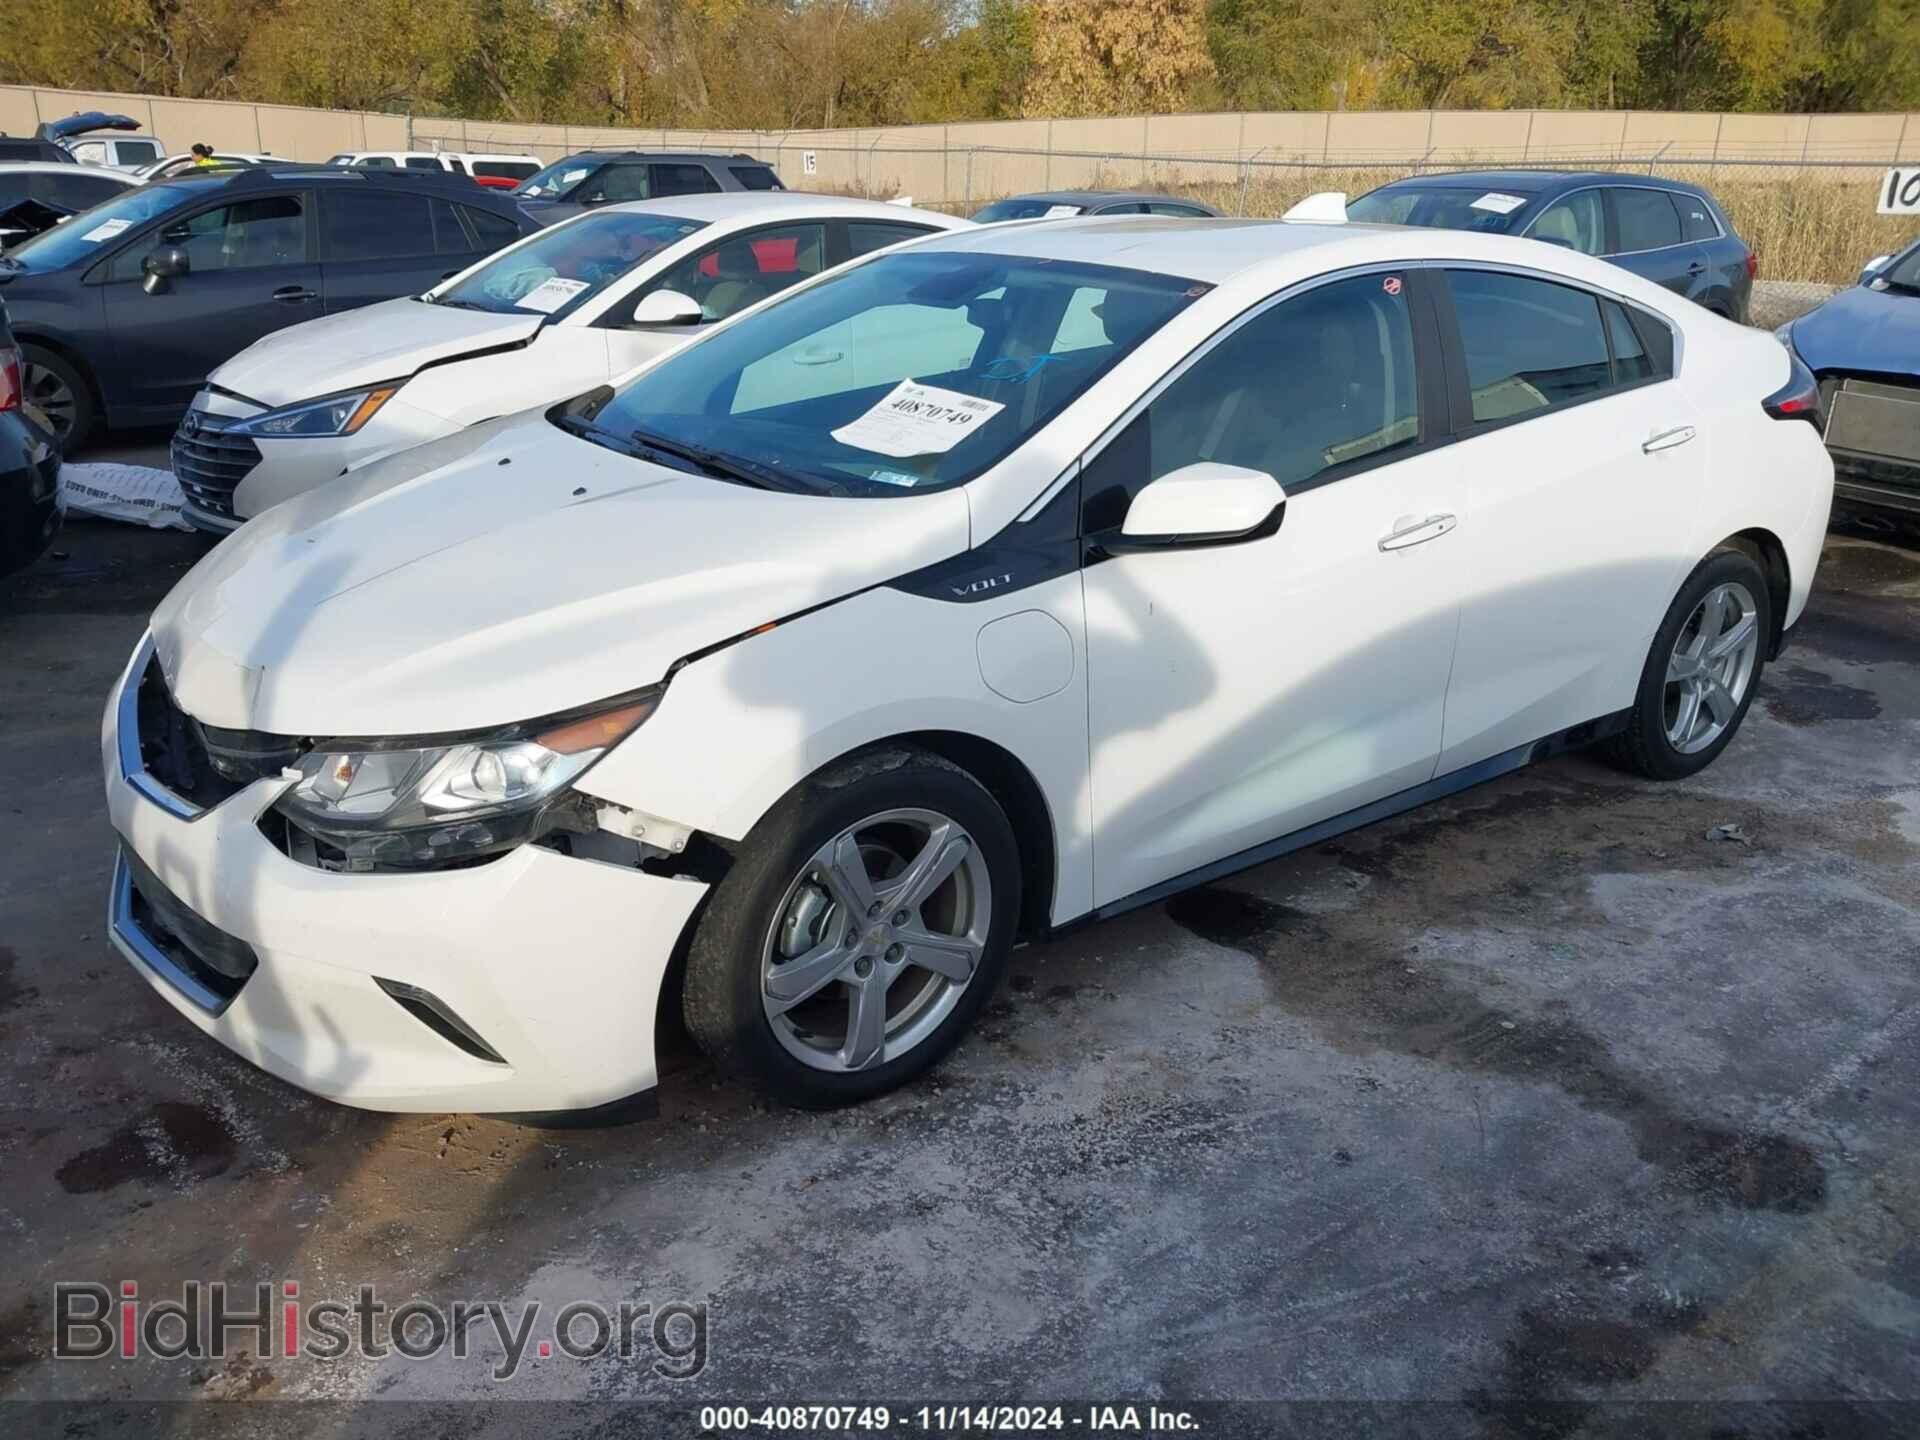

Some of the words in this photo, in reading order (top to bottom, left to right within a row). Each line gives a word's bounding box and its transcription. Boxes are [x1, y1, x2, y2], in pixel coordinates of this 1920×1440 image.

[805, 154, 815, 171] 15
[891, 399, 973, 424] 40870749
[952, 572, 1015, 596] VOLT
